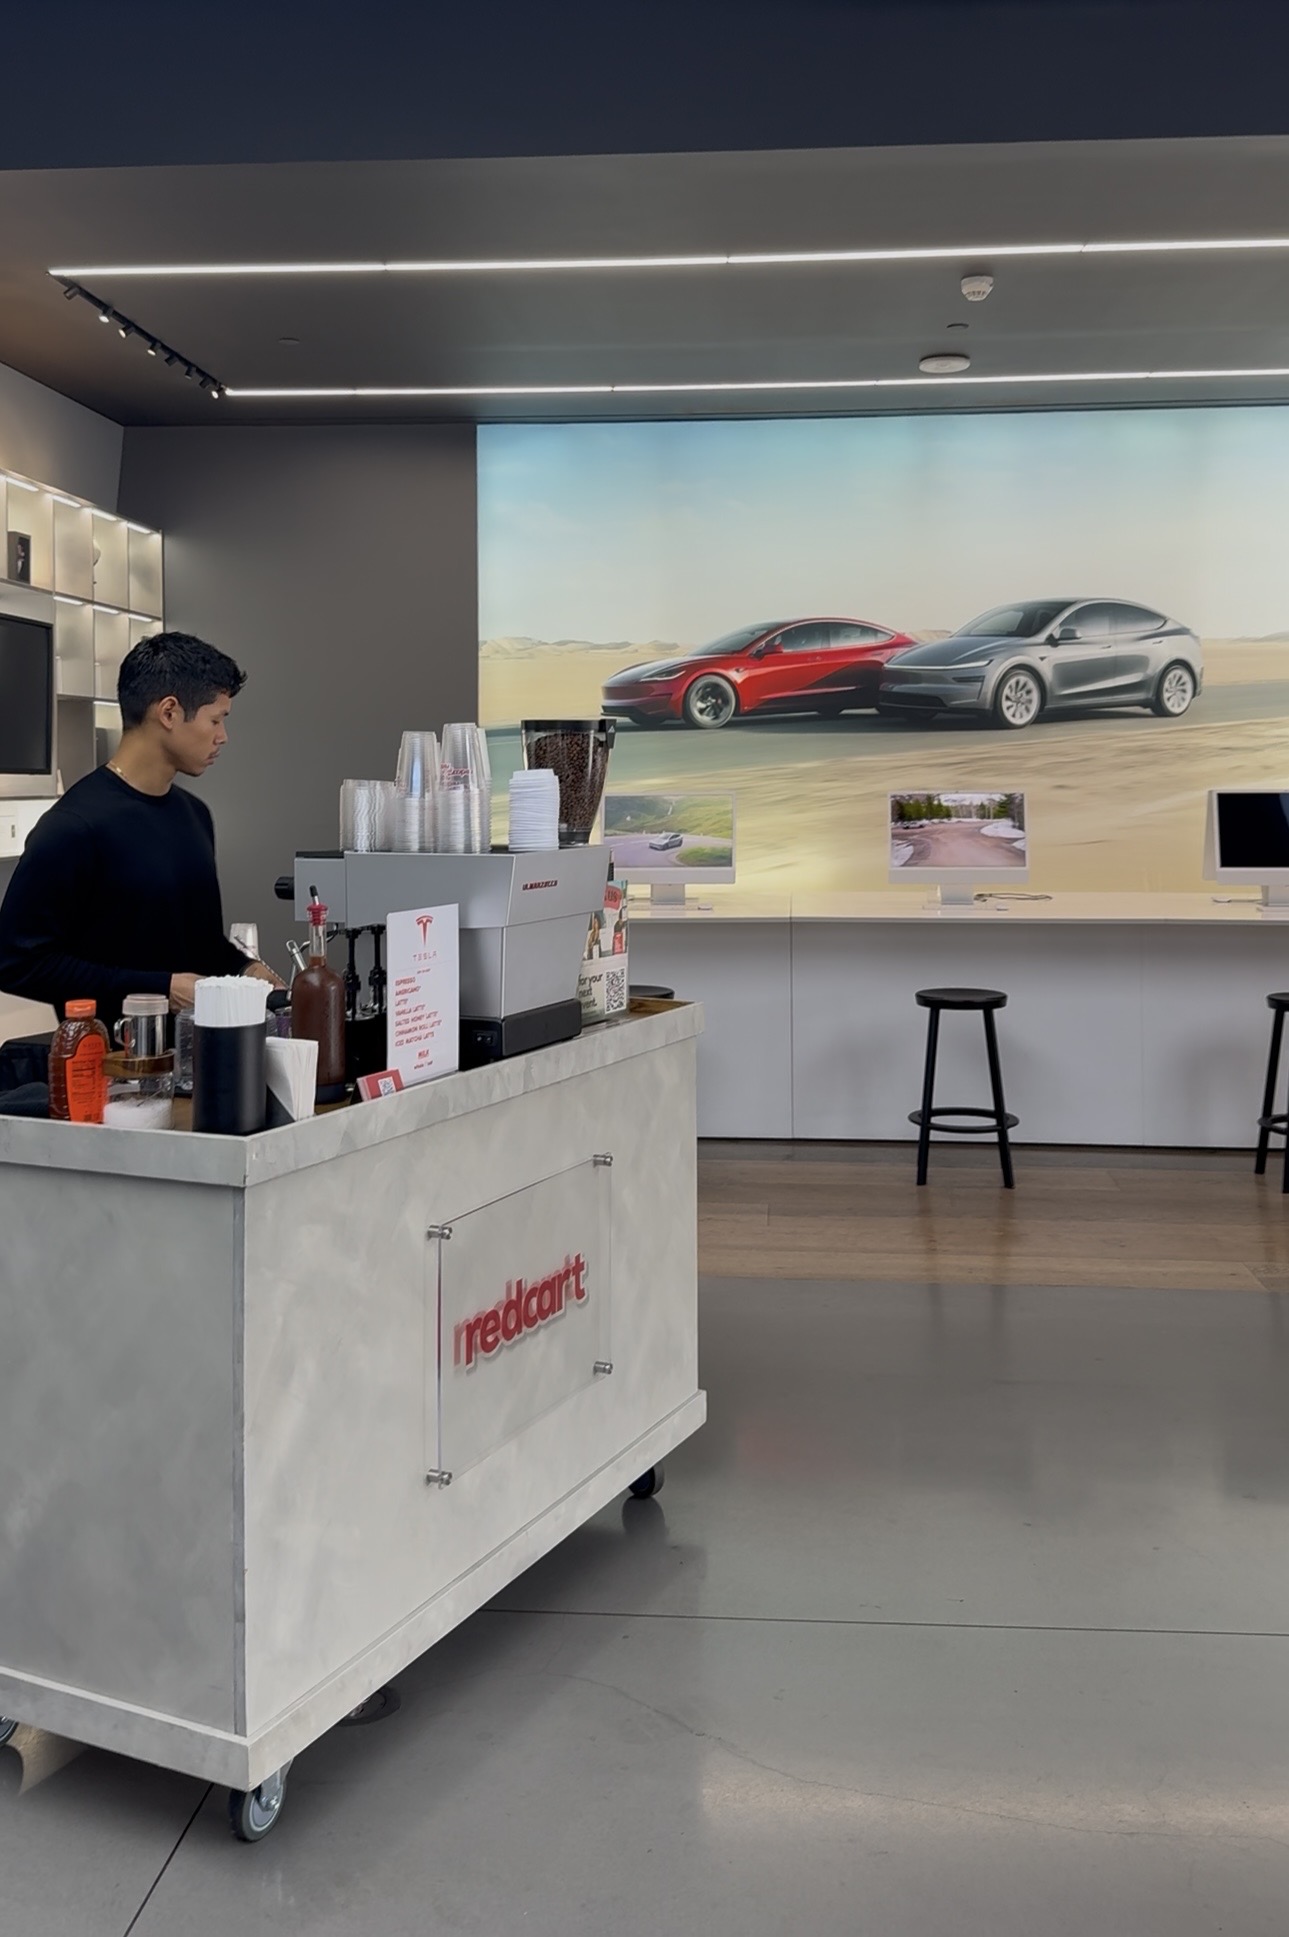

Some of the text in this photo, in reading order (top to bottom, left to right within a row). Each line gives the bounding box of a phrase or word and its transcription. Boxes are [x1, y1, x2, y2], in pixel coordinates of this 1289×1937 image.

[413, 951, 437, 961] TESLA
[395, 977, 416, 986] ESPRESSO
[588, 973, 603, 988] your
[579, 988, 592, 998] next
[466, 1253, 585, 1366] redcart
